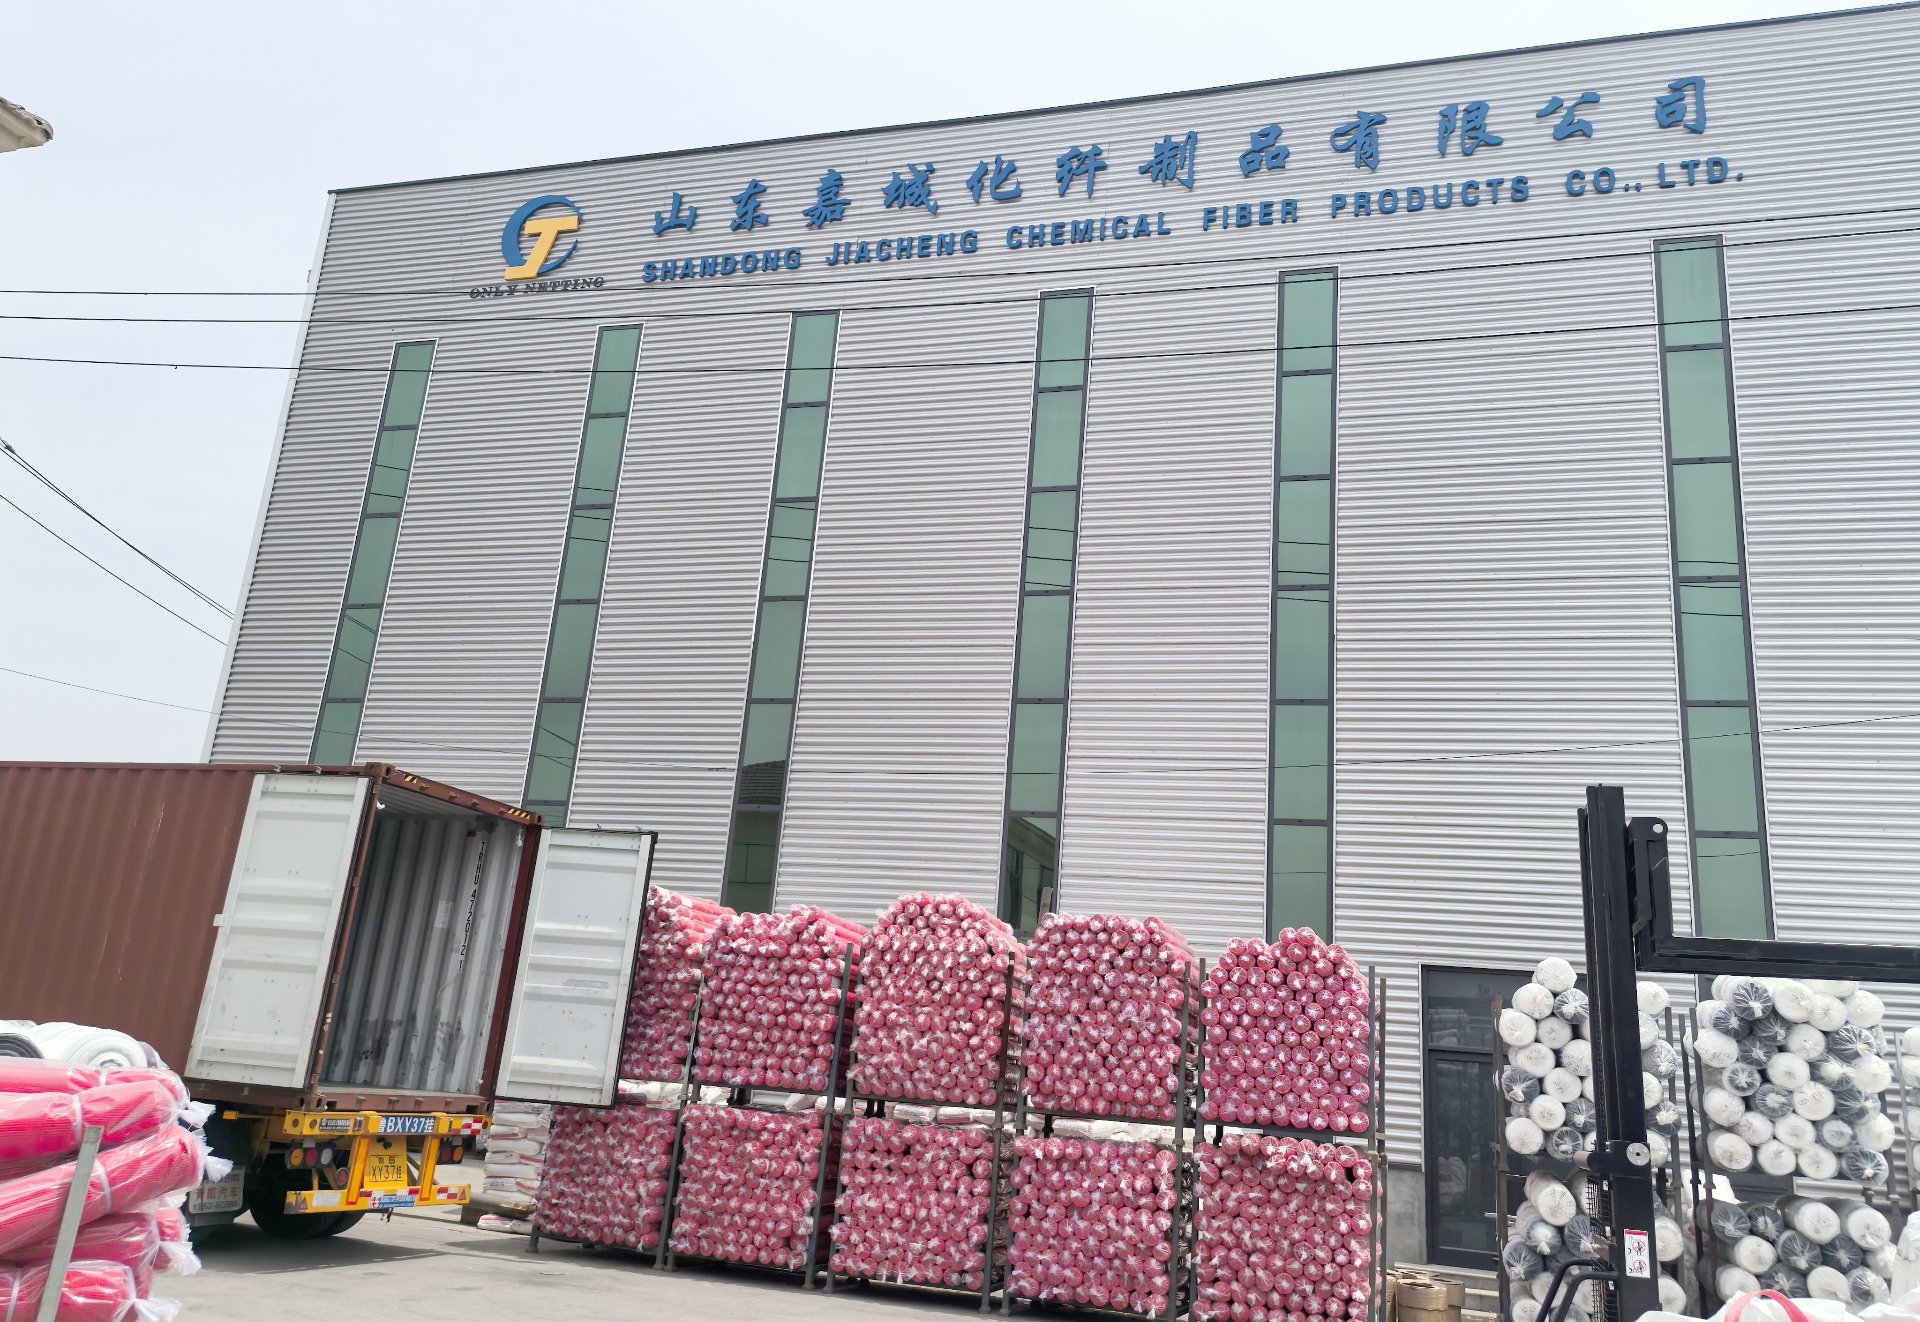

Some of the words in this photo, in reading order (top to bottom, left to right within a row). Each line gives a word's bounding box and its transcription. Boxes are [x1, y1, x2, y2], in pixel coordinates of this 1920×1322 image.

[654, 76, 1707, 236] 山东嘉城化纤制品有限公司
[642, 247, 801, 283] SHANDONG
[826, 229, 978, 266] JIACHENG
[1007, 211, 1171, 250] CHEMICAL
[1203, 198, 1298, 232] FIBER
[1331, 175, 1530, 219] PRODUCTS
[1658, 157, 1745, 189] LTD.
[470, 284, 518, 299] ONLY
[525, 276, 604, 294] NETTING
